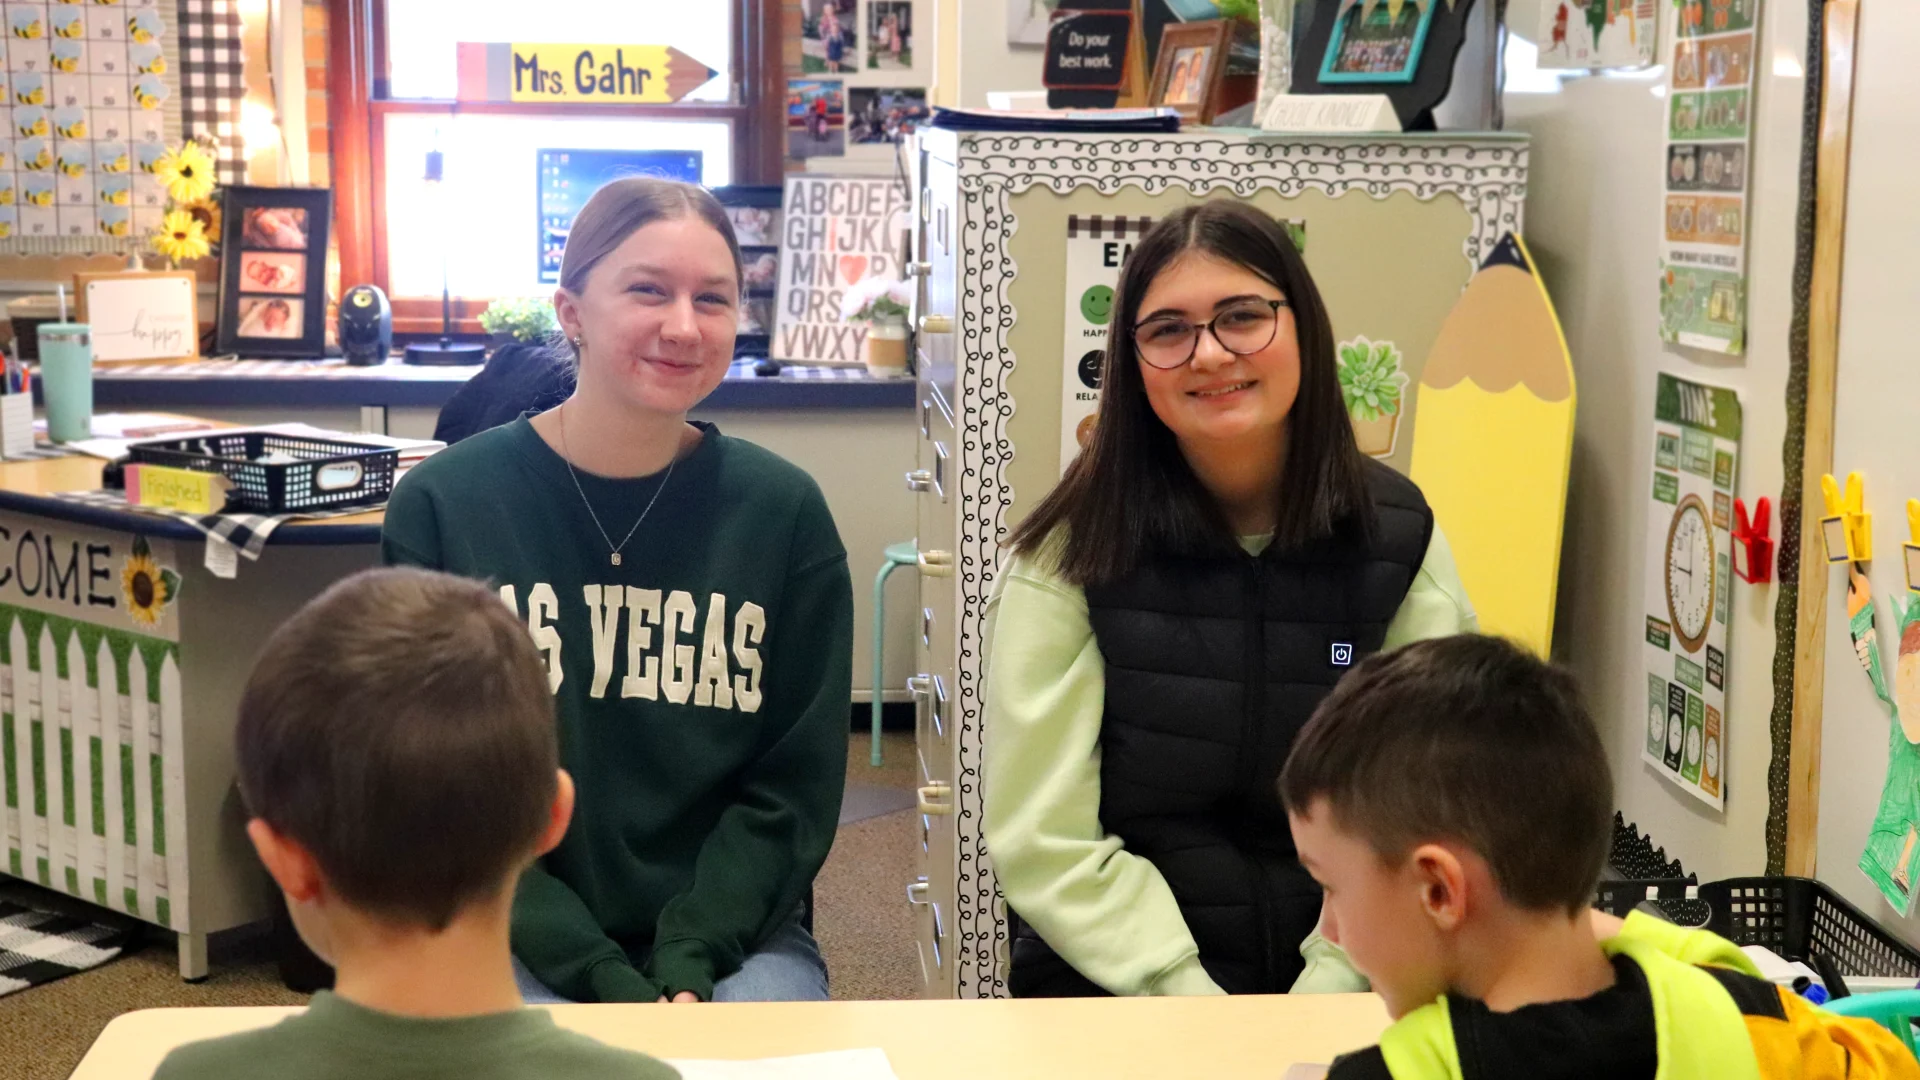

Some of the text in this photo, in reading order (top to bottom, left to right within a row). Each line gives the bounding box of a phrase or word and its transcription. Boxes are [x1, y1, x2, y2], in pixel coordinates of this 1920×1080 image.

[1068, 31, 1111, 49] Do your
[514, 48, 651, 95] Mrs. Gahr
[1058, 53, 1081, 68] best
[1083, 329, 1108, 338] HAPP
[1076, 392, 1099, 401] RELA
[1676, 381, 1717, 428] TIME
[147, 473, 203, 502] Finished
[583, 584, 767, 713] VEGAS
